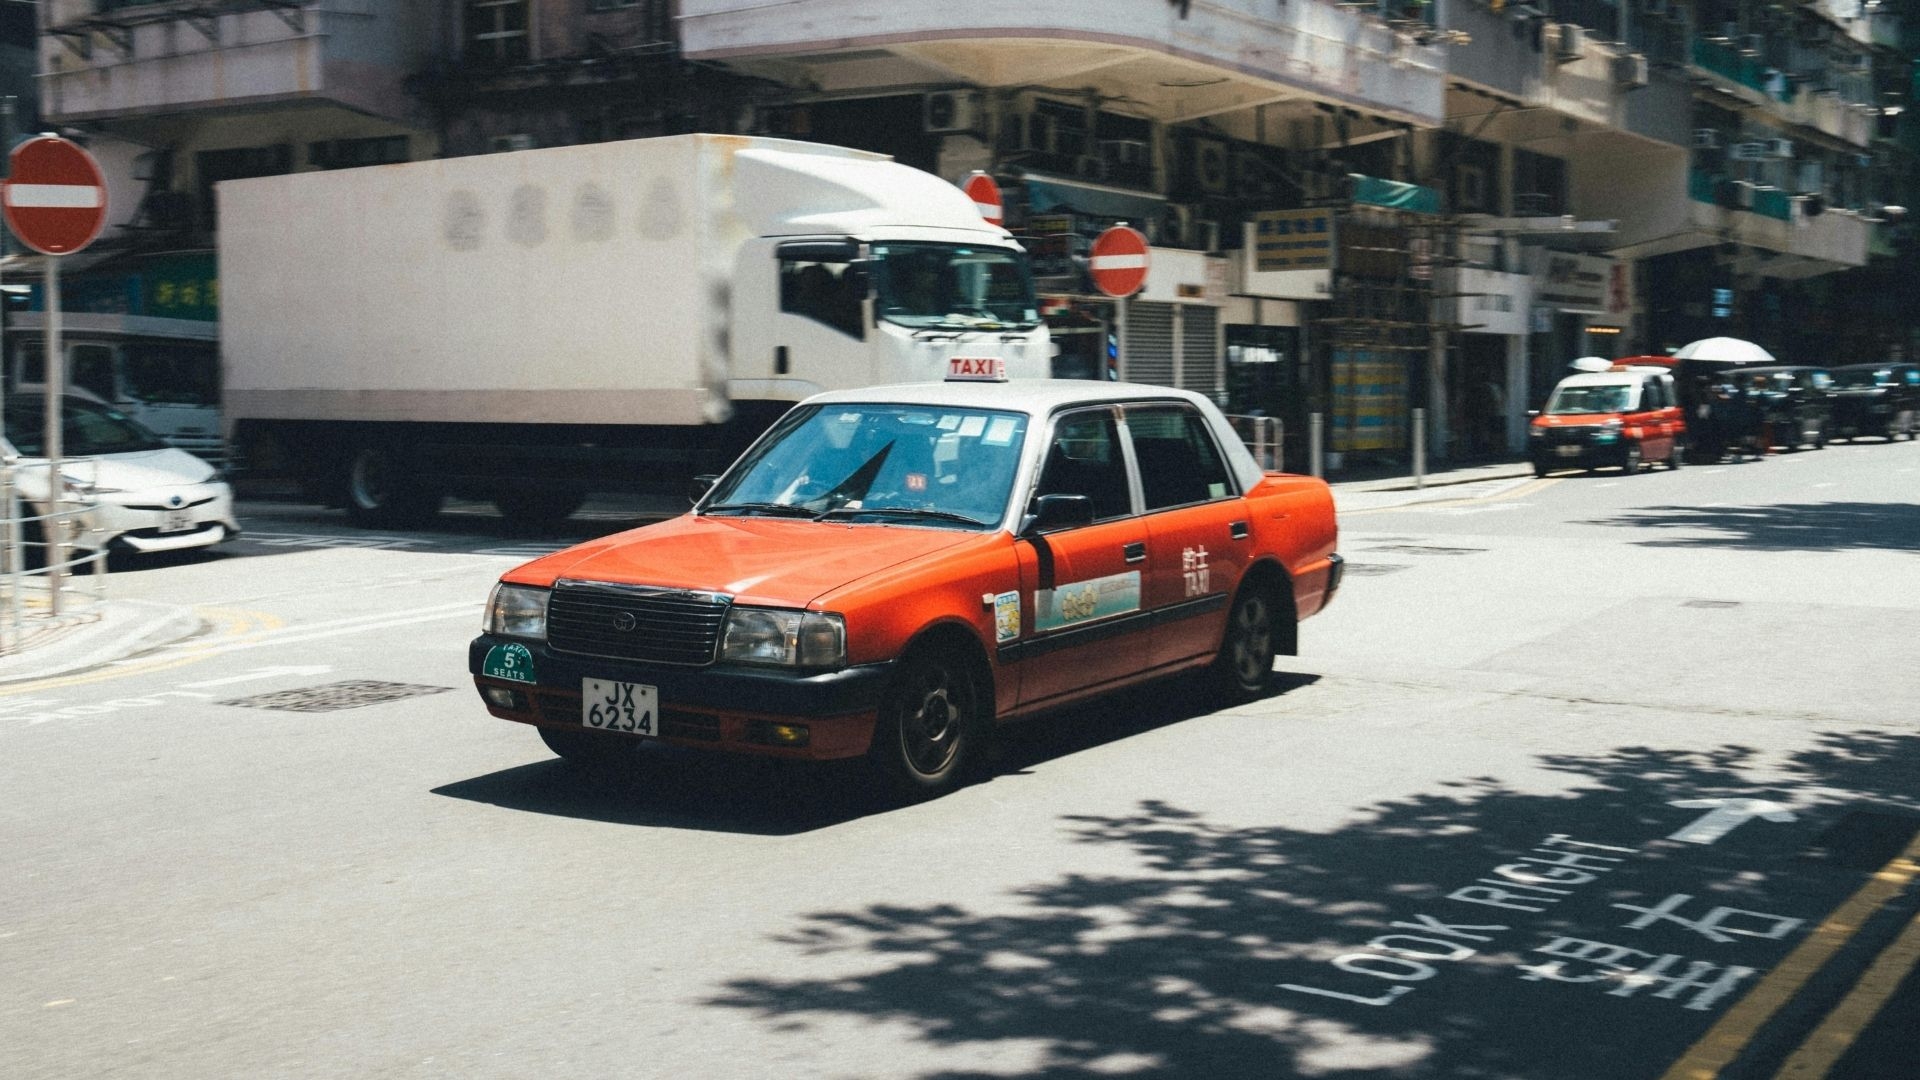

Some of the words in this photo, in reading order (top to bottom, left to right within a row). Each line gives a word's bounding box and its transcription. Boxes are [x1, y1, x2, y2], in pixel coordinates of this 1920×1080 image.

[951, 359, 994, 375] TAXI
[503, 652, 515, 669] 5
[493, 667, 525, 680] SEATS
[605, 682, 635, 708] JX
[588, 703, 652, 735] 6234
[1276, 914, 1511, 1006] LOOK
[1445, 833, 1640, 913] RIGHT
